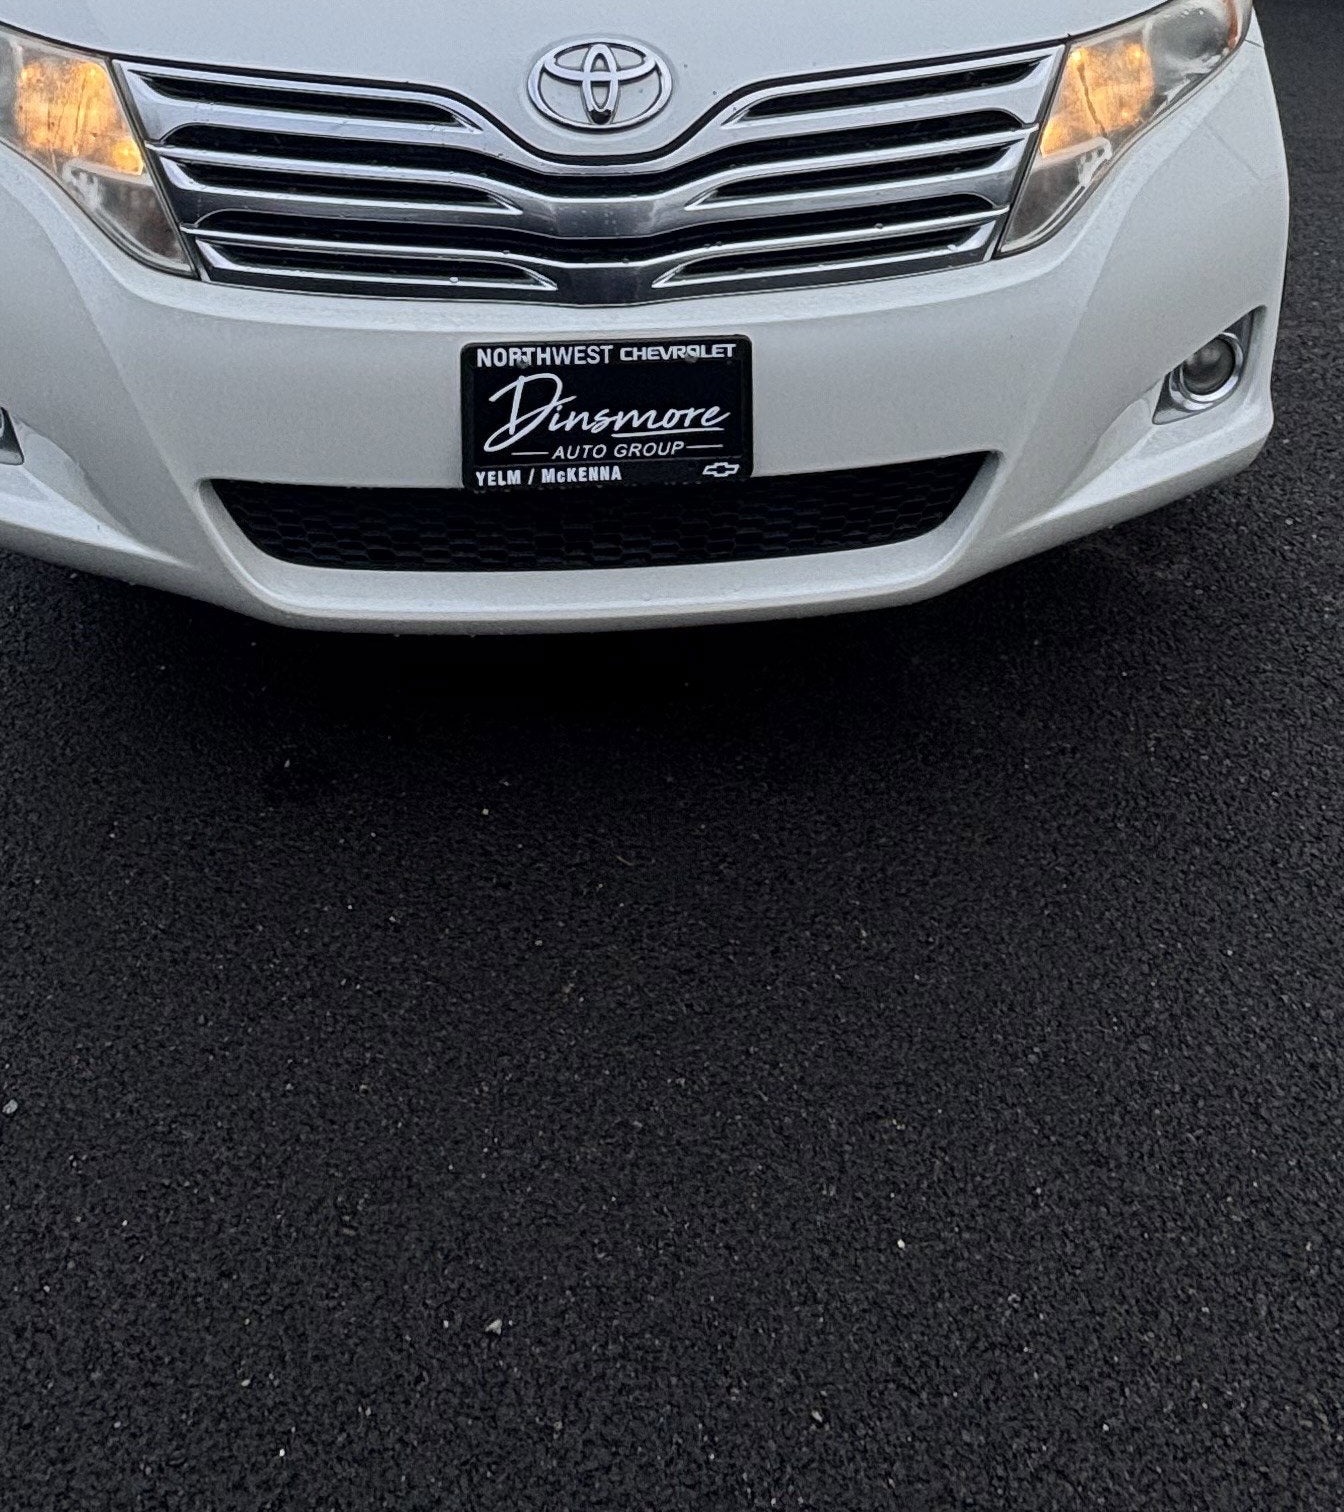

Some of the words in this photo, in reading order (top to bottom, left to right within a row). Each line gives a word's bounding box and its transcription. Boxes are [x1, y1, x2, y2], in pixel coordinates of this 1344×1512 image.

[476, 345, 614, 368] NORTHWEST
[619, 344, 737, 362] CHEVROLET
[483, 373, 731, 452] Dinsmore
[552, 443, 606, 460] AUTO
[613, 441, 685, 458] GROUP
[475, 469, 522, 487] YELM
[541, 465, 623, 484] McKENNA
